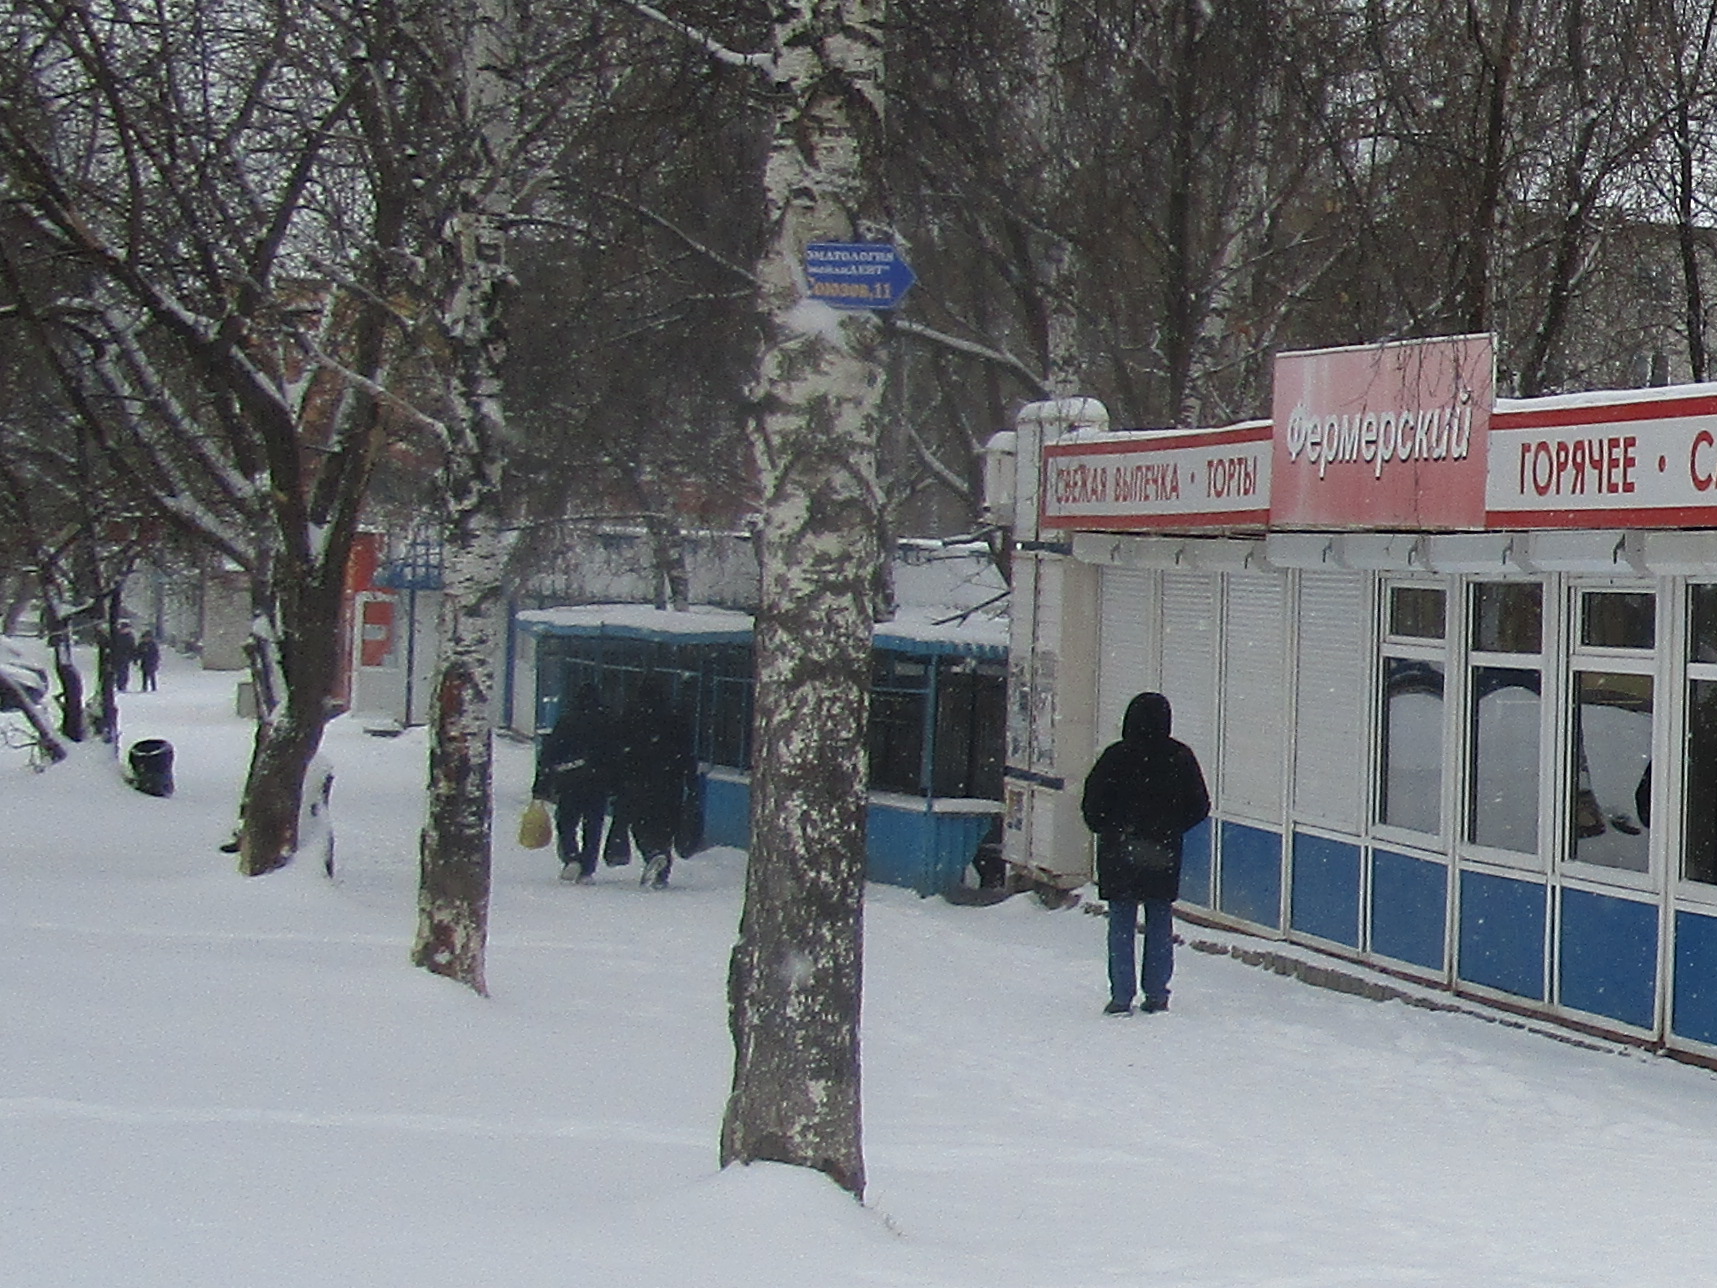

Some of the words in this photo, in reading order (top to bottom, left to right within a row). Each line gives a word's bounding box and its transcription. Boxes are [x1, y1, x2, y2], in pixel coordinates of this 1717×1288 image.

[1287, 390, 1473, 478] Фермерский
[1056, 464, 1108, 504] СВЕЖАЯ
[1114, 463, 1180, 503] ВЫПЕЧКА
[1206, 456, 1258, 499] ТОРТЫ
[1519, 436, 1637, 497] ГОРЯЧЕЕ
